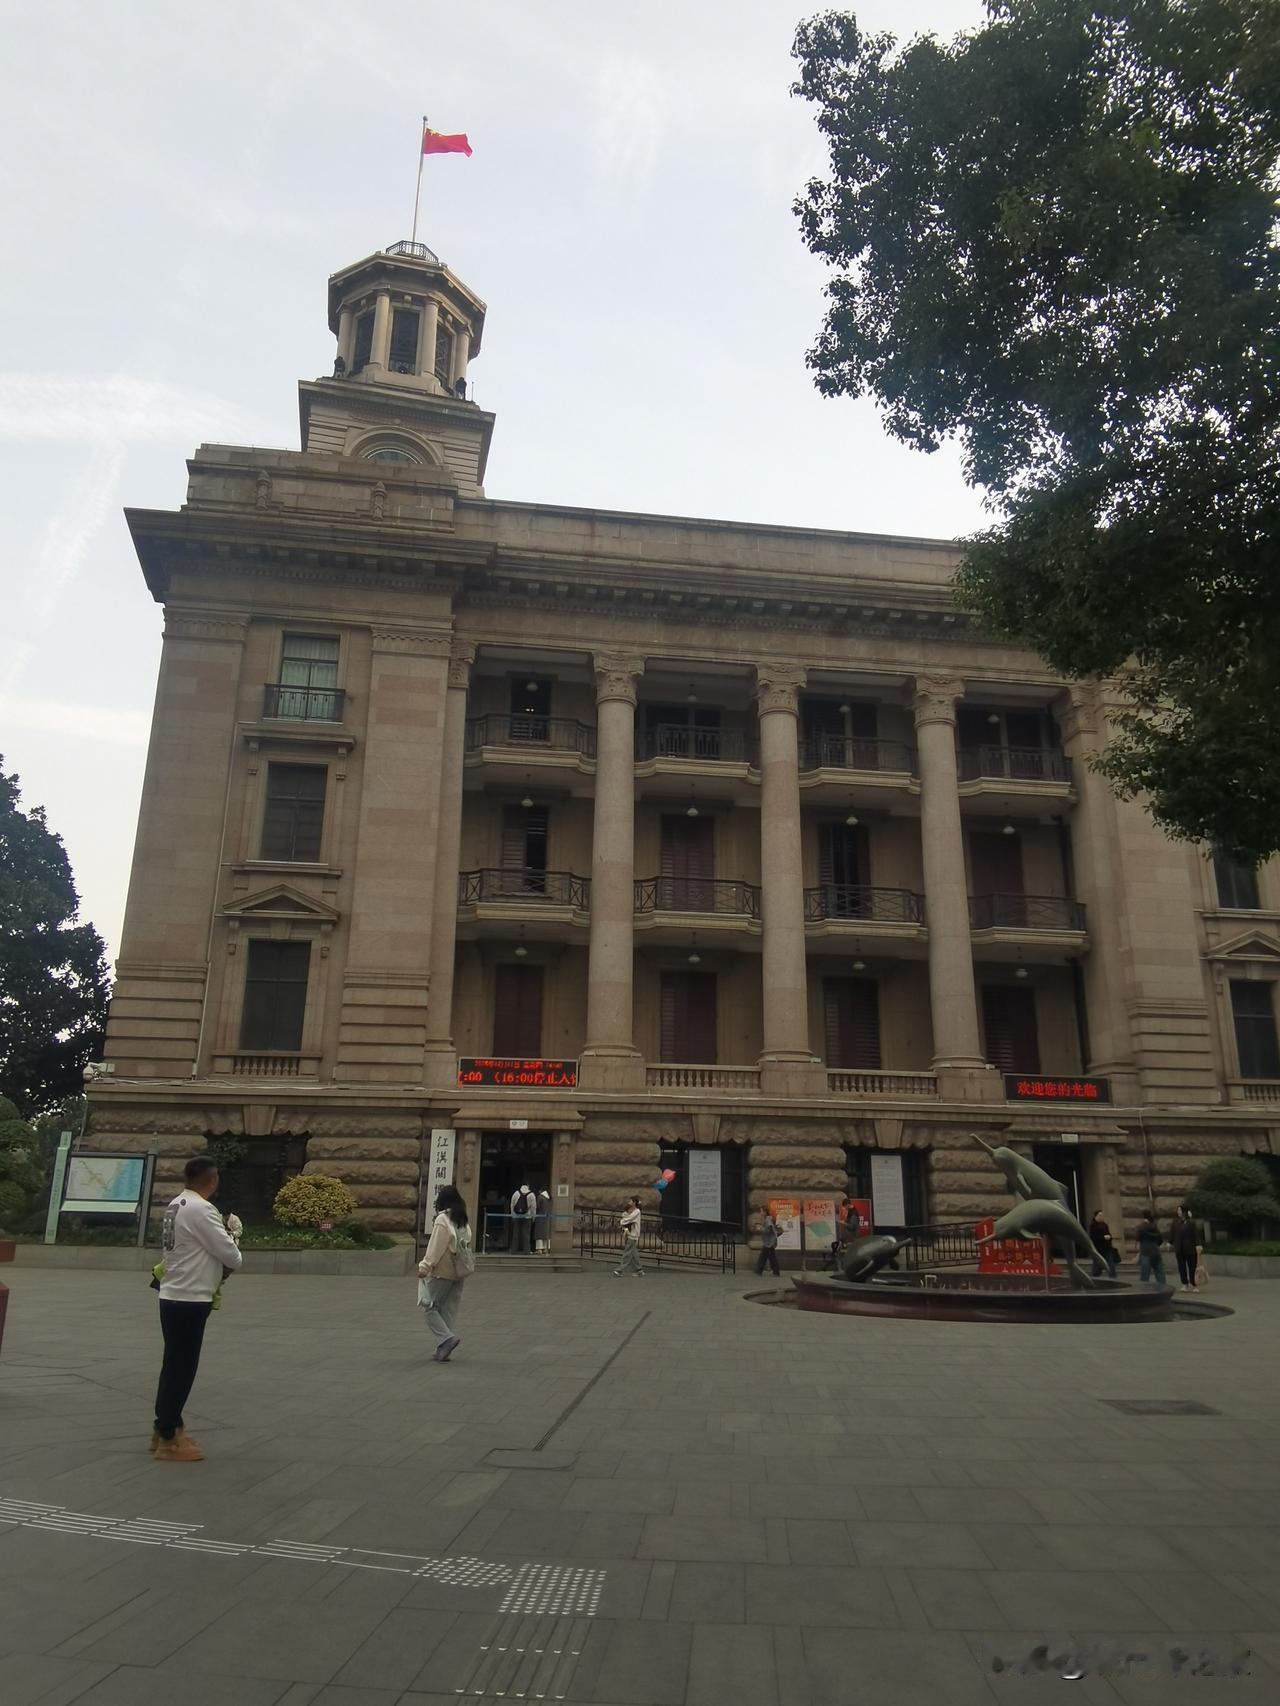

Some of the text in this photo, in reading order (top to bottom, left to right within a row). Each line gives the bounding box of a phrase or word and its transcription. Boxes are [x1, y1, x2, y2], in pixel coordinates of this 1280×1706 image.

[1017, 1081, 1097, 1098] 欢迎您的光临
[432, 1136, 449, 1227] 江漢關
